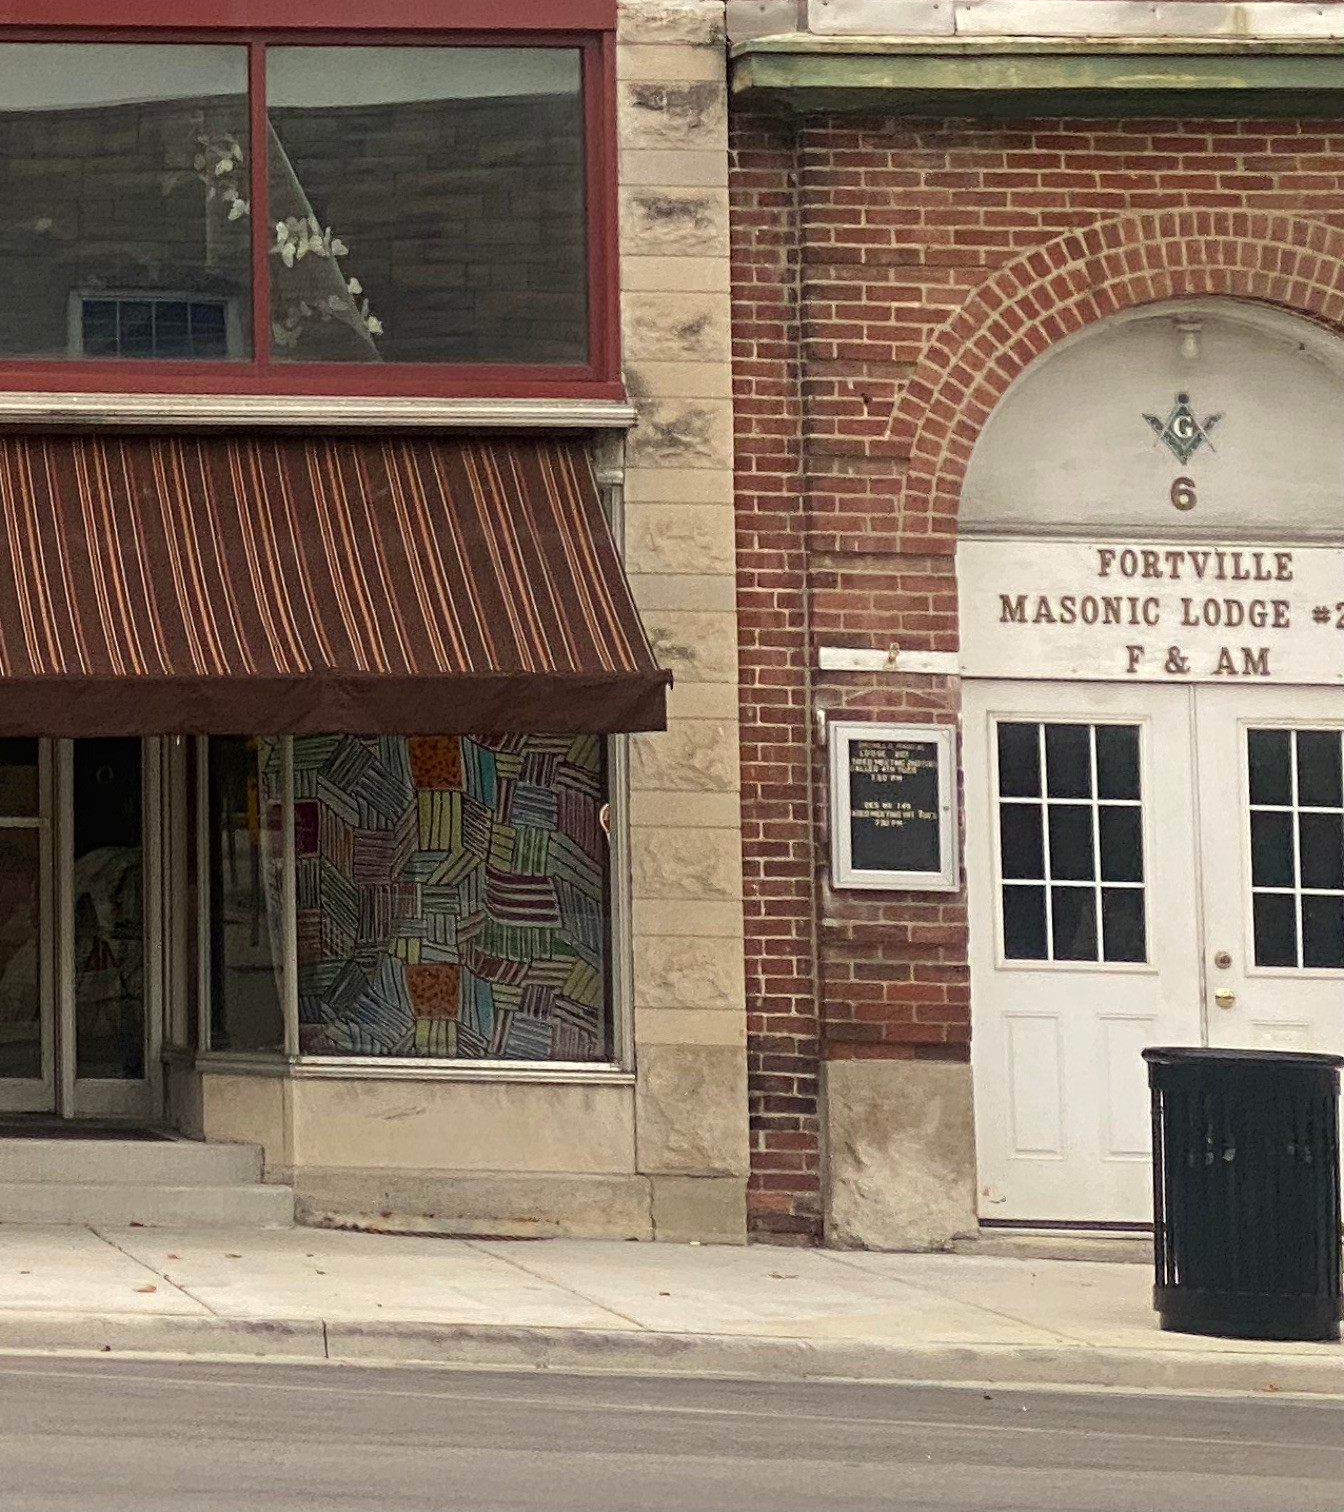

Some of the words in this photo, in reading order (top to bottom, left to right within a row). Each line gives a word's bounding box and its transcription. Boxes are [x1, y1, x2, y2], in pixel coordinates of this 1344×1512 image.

[1173, 416, 1194, 439] G
[1170, 477, 1198, 511] 6
[1097, 549, 1294, 581] FORTVILLE
[999, 594, 1161, 625] MASONIC
[1180, 598, 1291, 629] LODGE
[1125, 645, 1145, 674] F
[1164, 646, 1191, 675] &
[1213, 647, 1271, 676] AM
